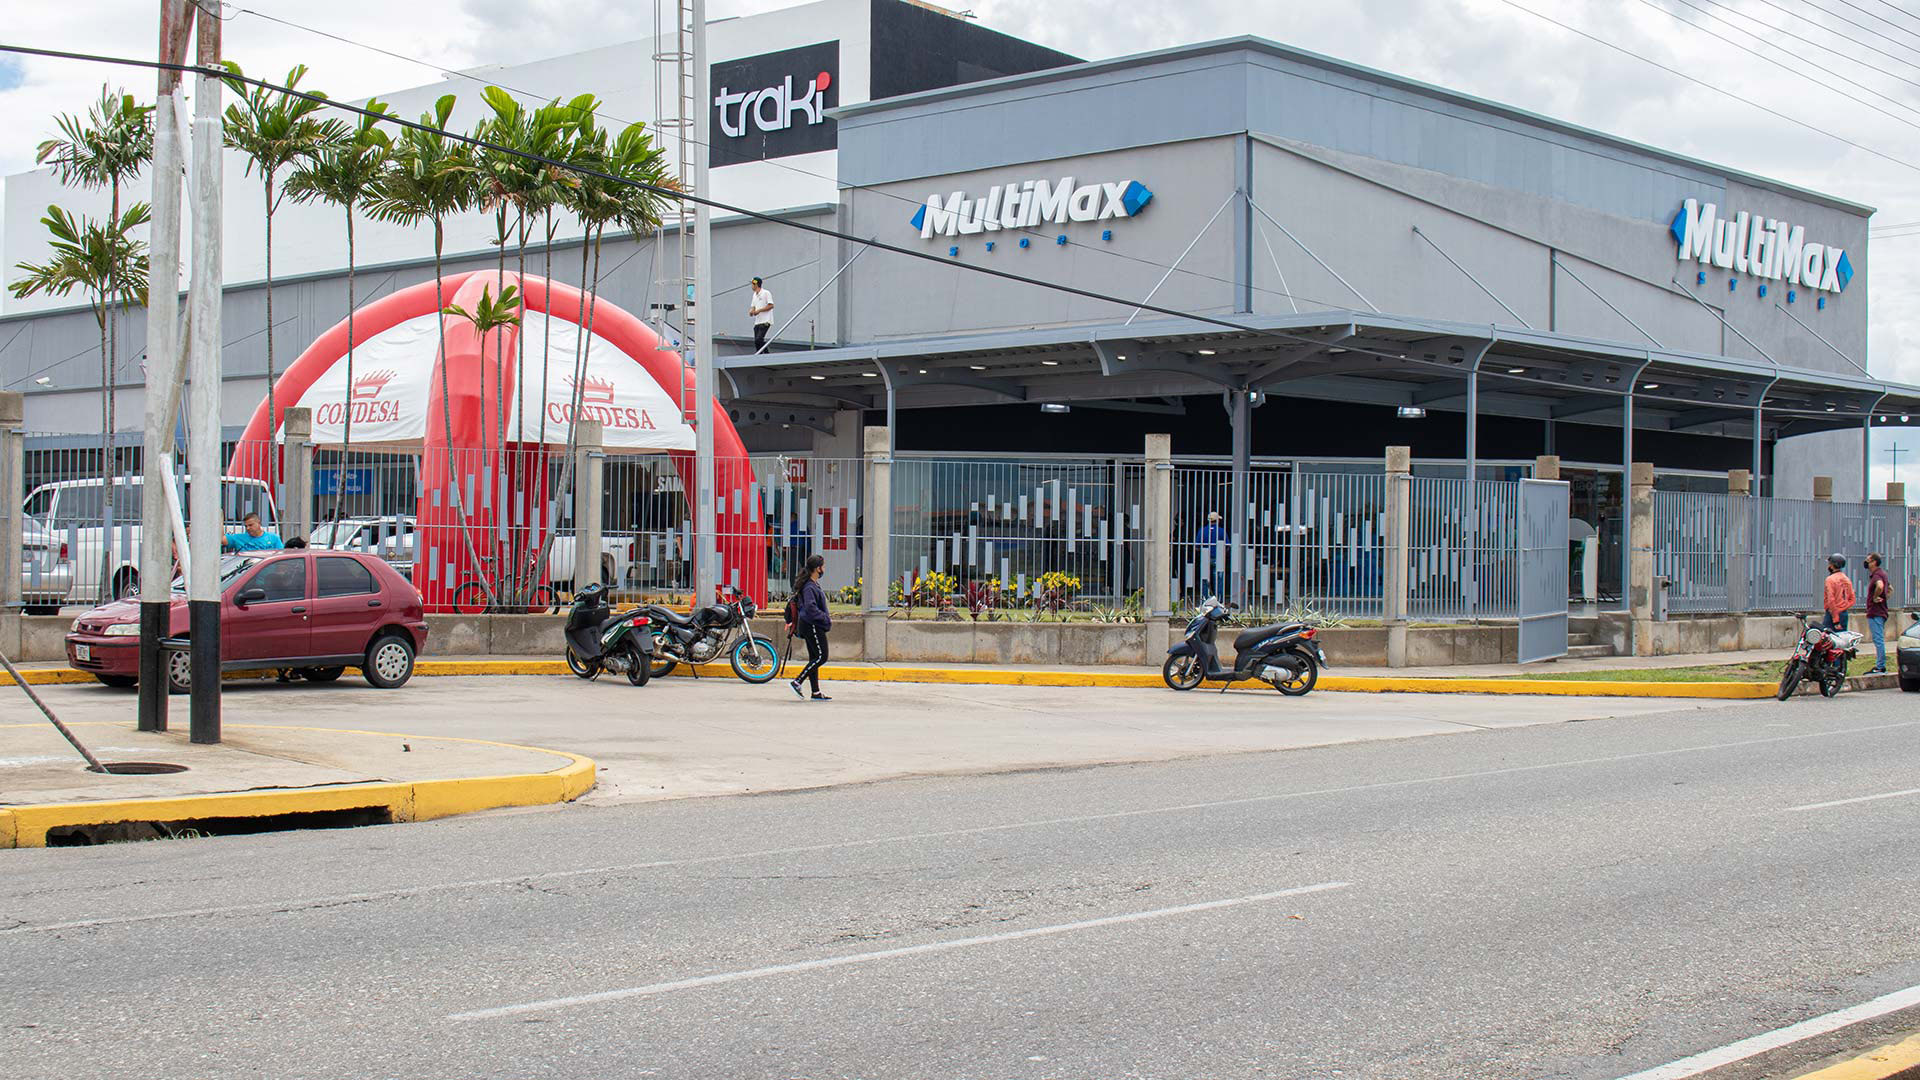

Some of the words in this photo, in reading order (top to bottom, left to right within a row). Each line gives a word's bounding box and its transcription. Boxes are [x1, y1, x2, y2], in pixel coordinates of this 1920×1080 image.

[715, 71, 831, 137] traki
[920, 177, 1132, 239] MultiMax
[949, 230, 1112, 256] STORE
[1678, 198, 1844, 293] MultiMax
[1697, 271, 1826, 310] STORE
[316, 399, 400, 425] CONDESA
[547, 402, 657, 430] CONDESA
